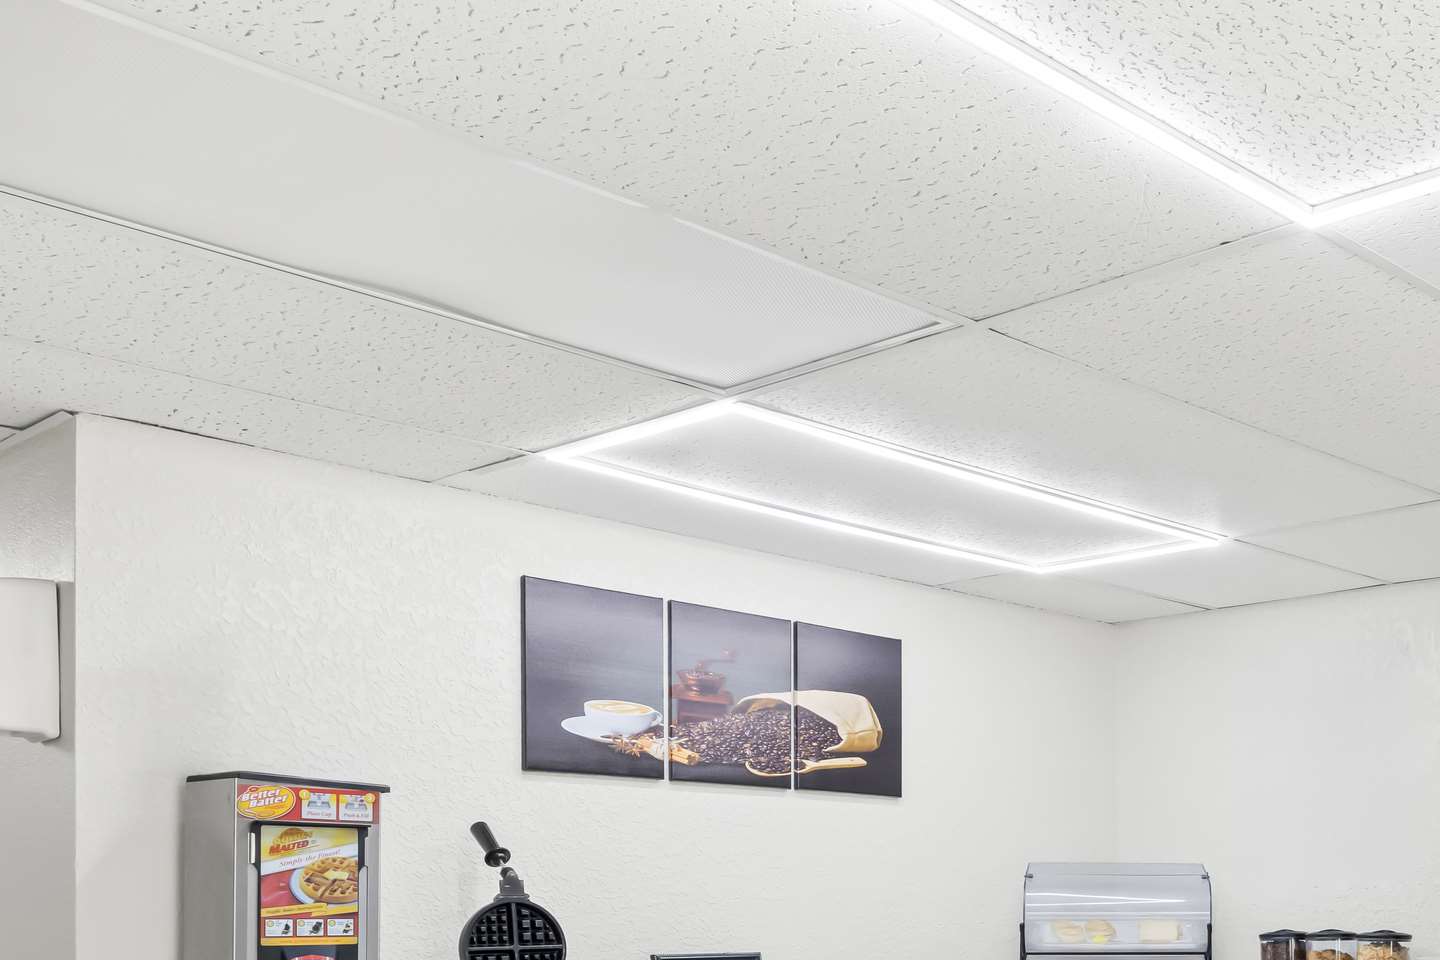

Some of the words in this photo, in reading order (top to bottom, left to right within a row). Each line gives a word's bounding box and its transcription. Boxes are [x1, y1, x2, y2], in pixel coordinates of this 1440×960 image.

[240, 788, 281, 801] Better
[249, 794, 289, 808] Batter
[268, 839, 310, 856] MALTED
